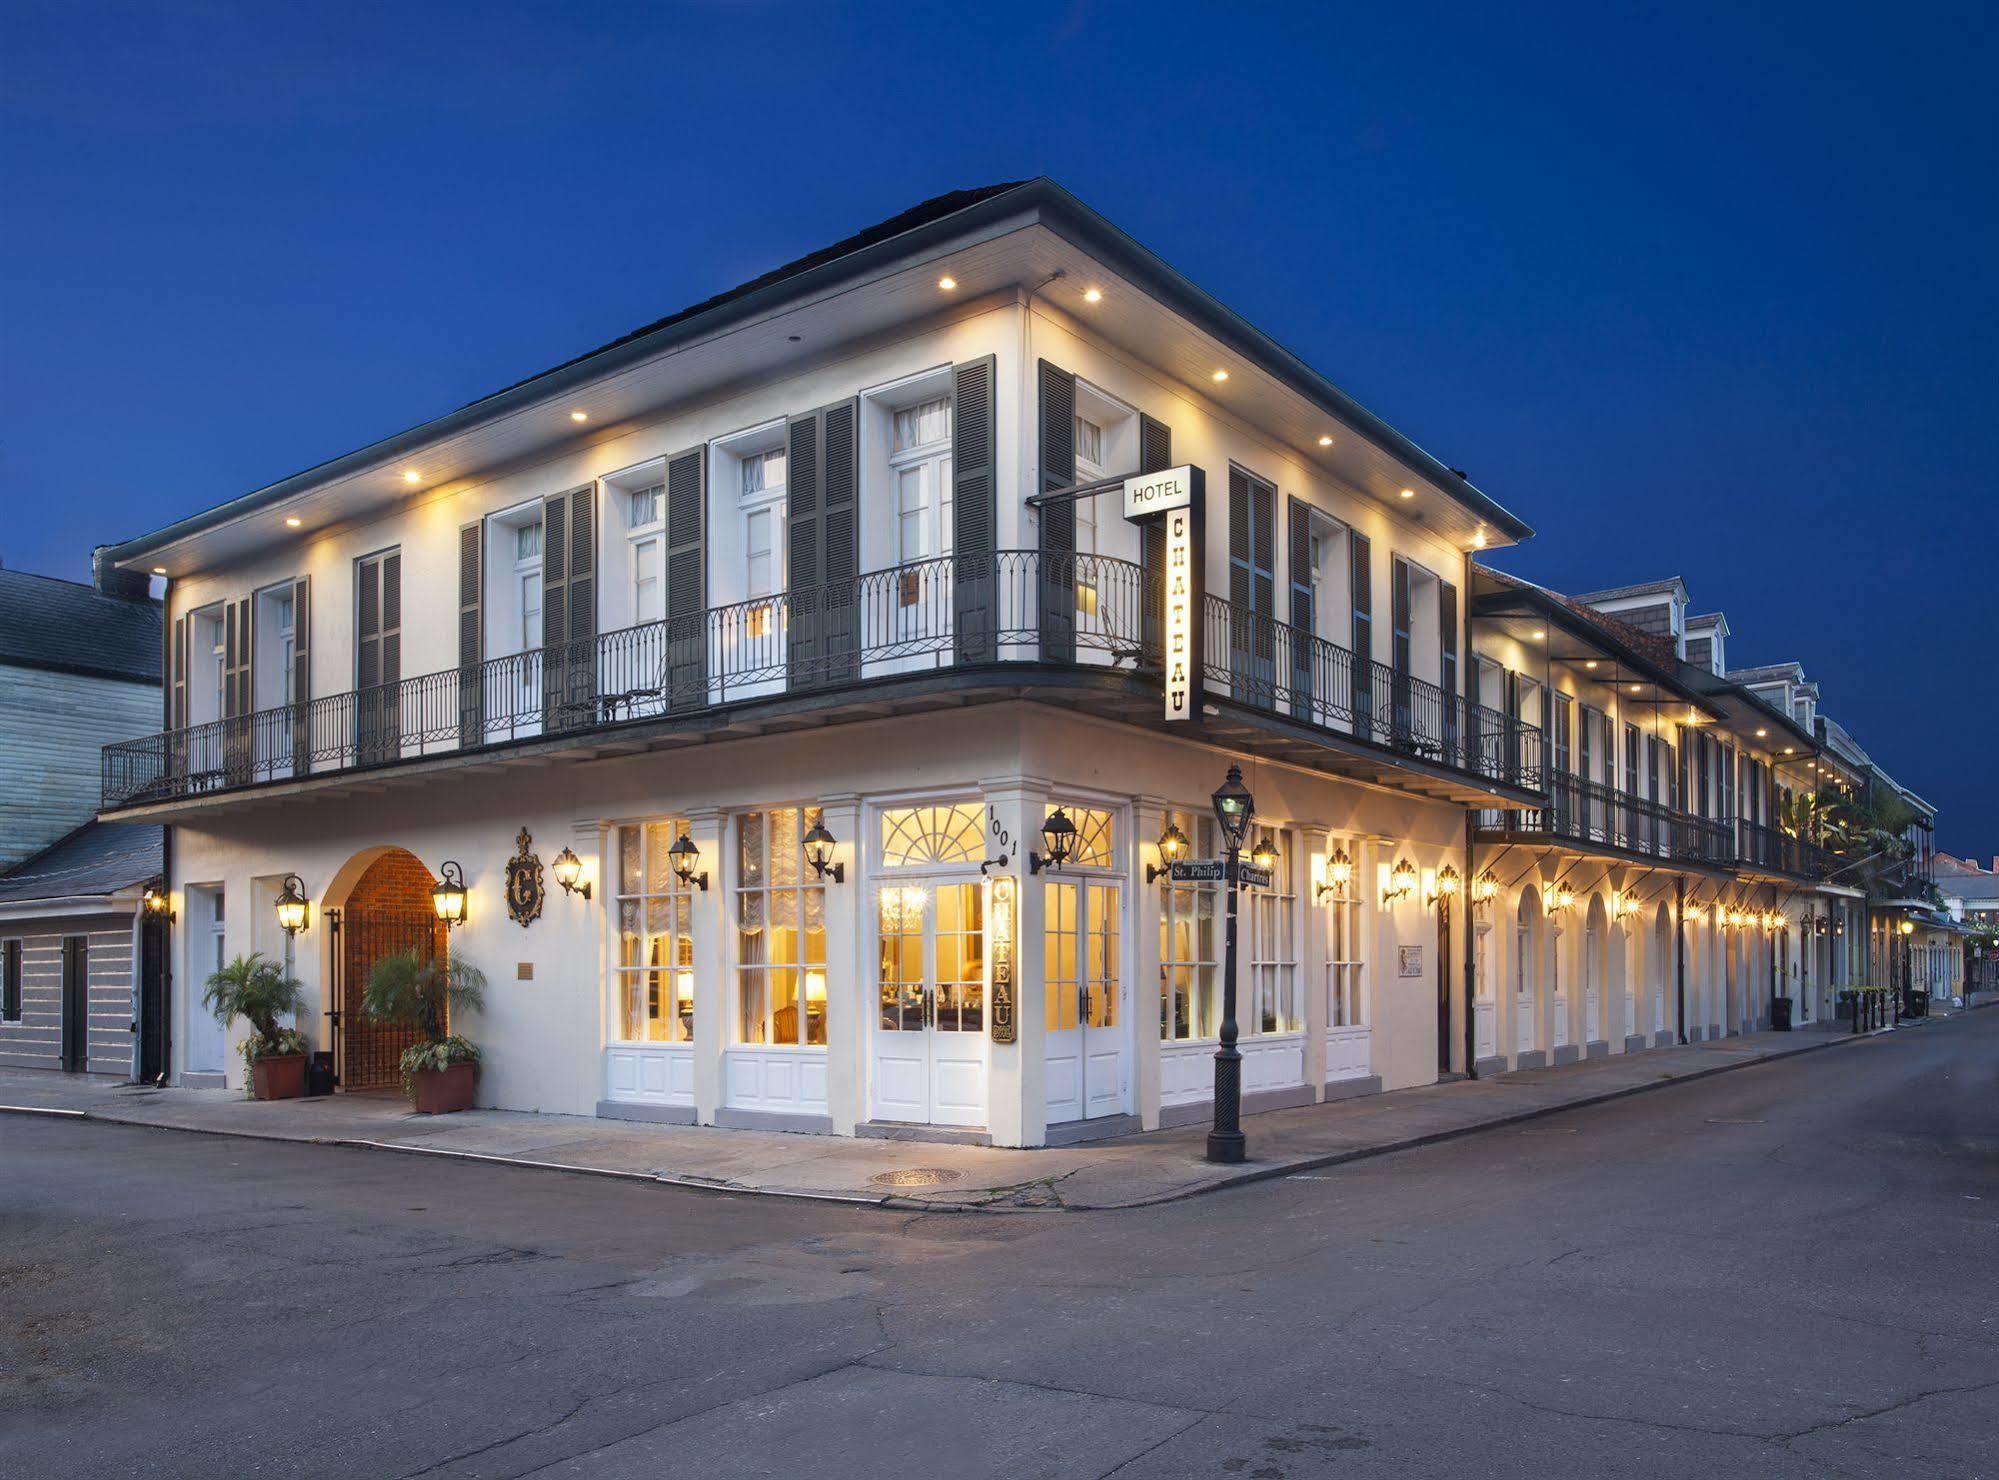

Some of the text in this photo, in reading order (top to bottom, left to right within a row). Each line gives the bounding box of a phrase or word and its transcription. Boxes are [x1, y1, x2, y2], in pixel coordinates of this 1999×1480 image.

[1133, 480, 1182, 503] HOTEL
[1171, 517, 1185, 711] CHATEAU
[989, 805, 1017, 856] 1001
[1173, 865, 1220, 880] St. Philip
[994, 881, 1011, 1025] CHATEAU
